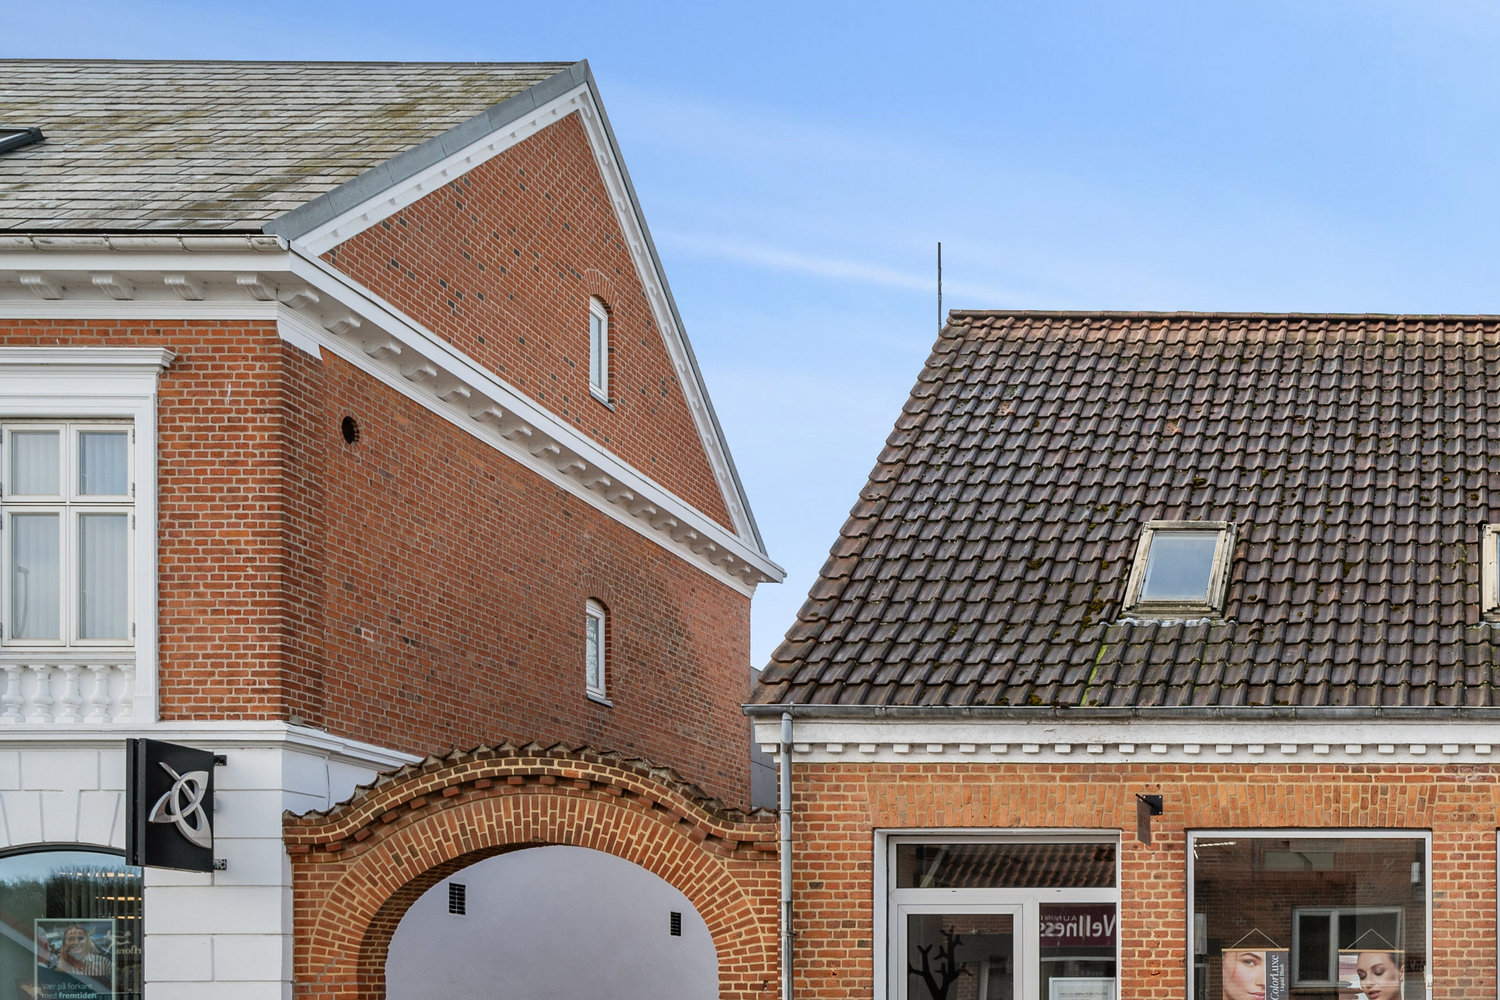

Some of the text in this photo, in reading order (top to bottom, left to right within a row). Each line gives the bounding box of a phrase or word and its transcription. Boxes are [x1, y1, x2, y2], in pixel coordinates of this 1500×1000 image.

[57, 982, 66, 991] på
[67, 982, 93, 990] forkant
[1270, 954, 1280, 1000] ColorLuxe
